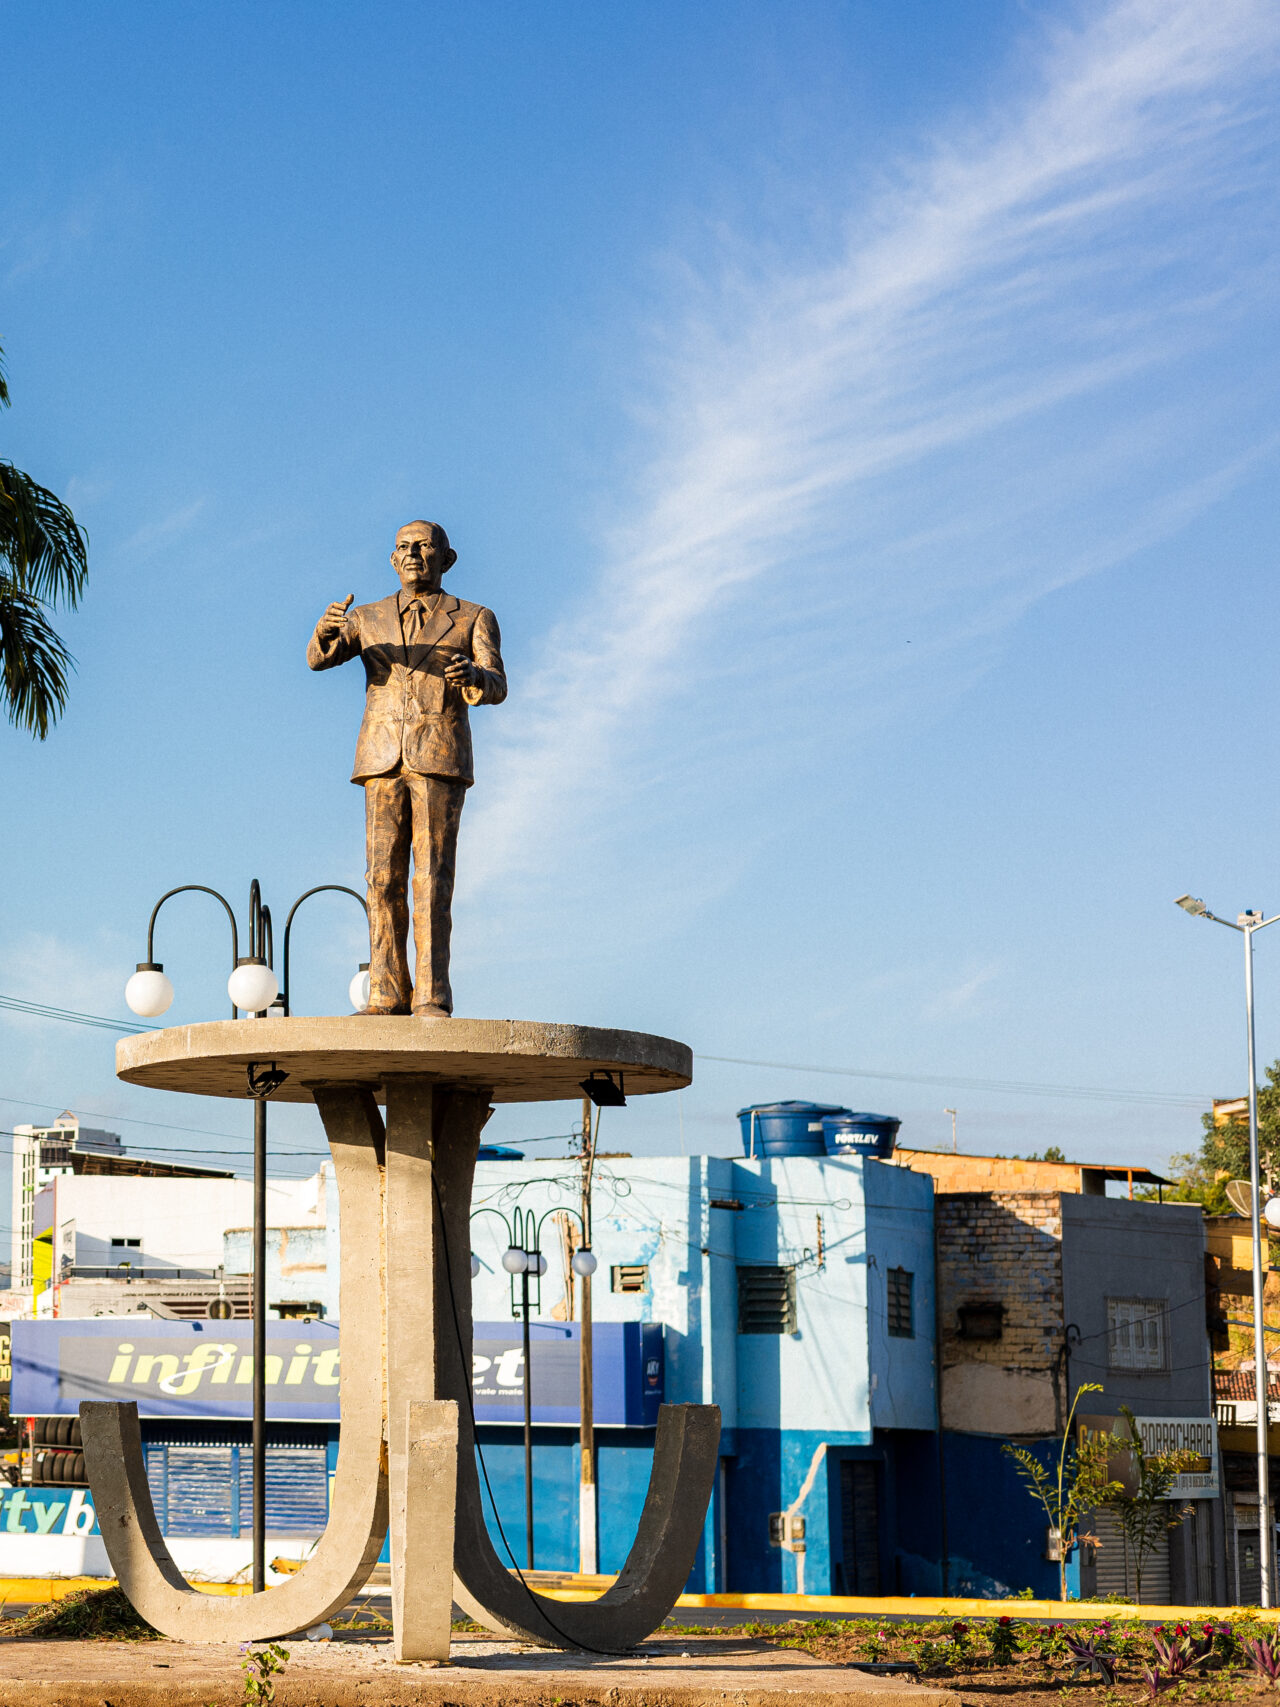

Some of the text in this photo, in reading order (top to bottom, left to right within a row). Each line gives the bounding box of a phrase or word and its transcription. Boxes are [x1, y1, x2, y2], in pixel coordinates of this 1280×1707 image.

[834, 1133, 879, 1144] FORTLEV
[474, 1387, 497, 1396] vale
[1141, 1423, 1213, 1456] BORRACHARIA
